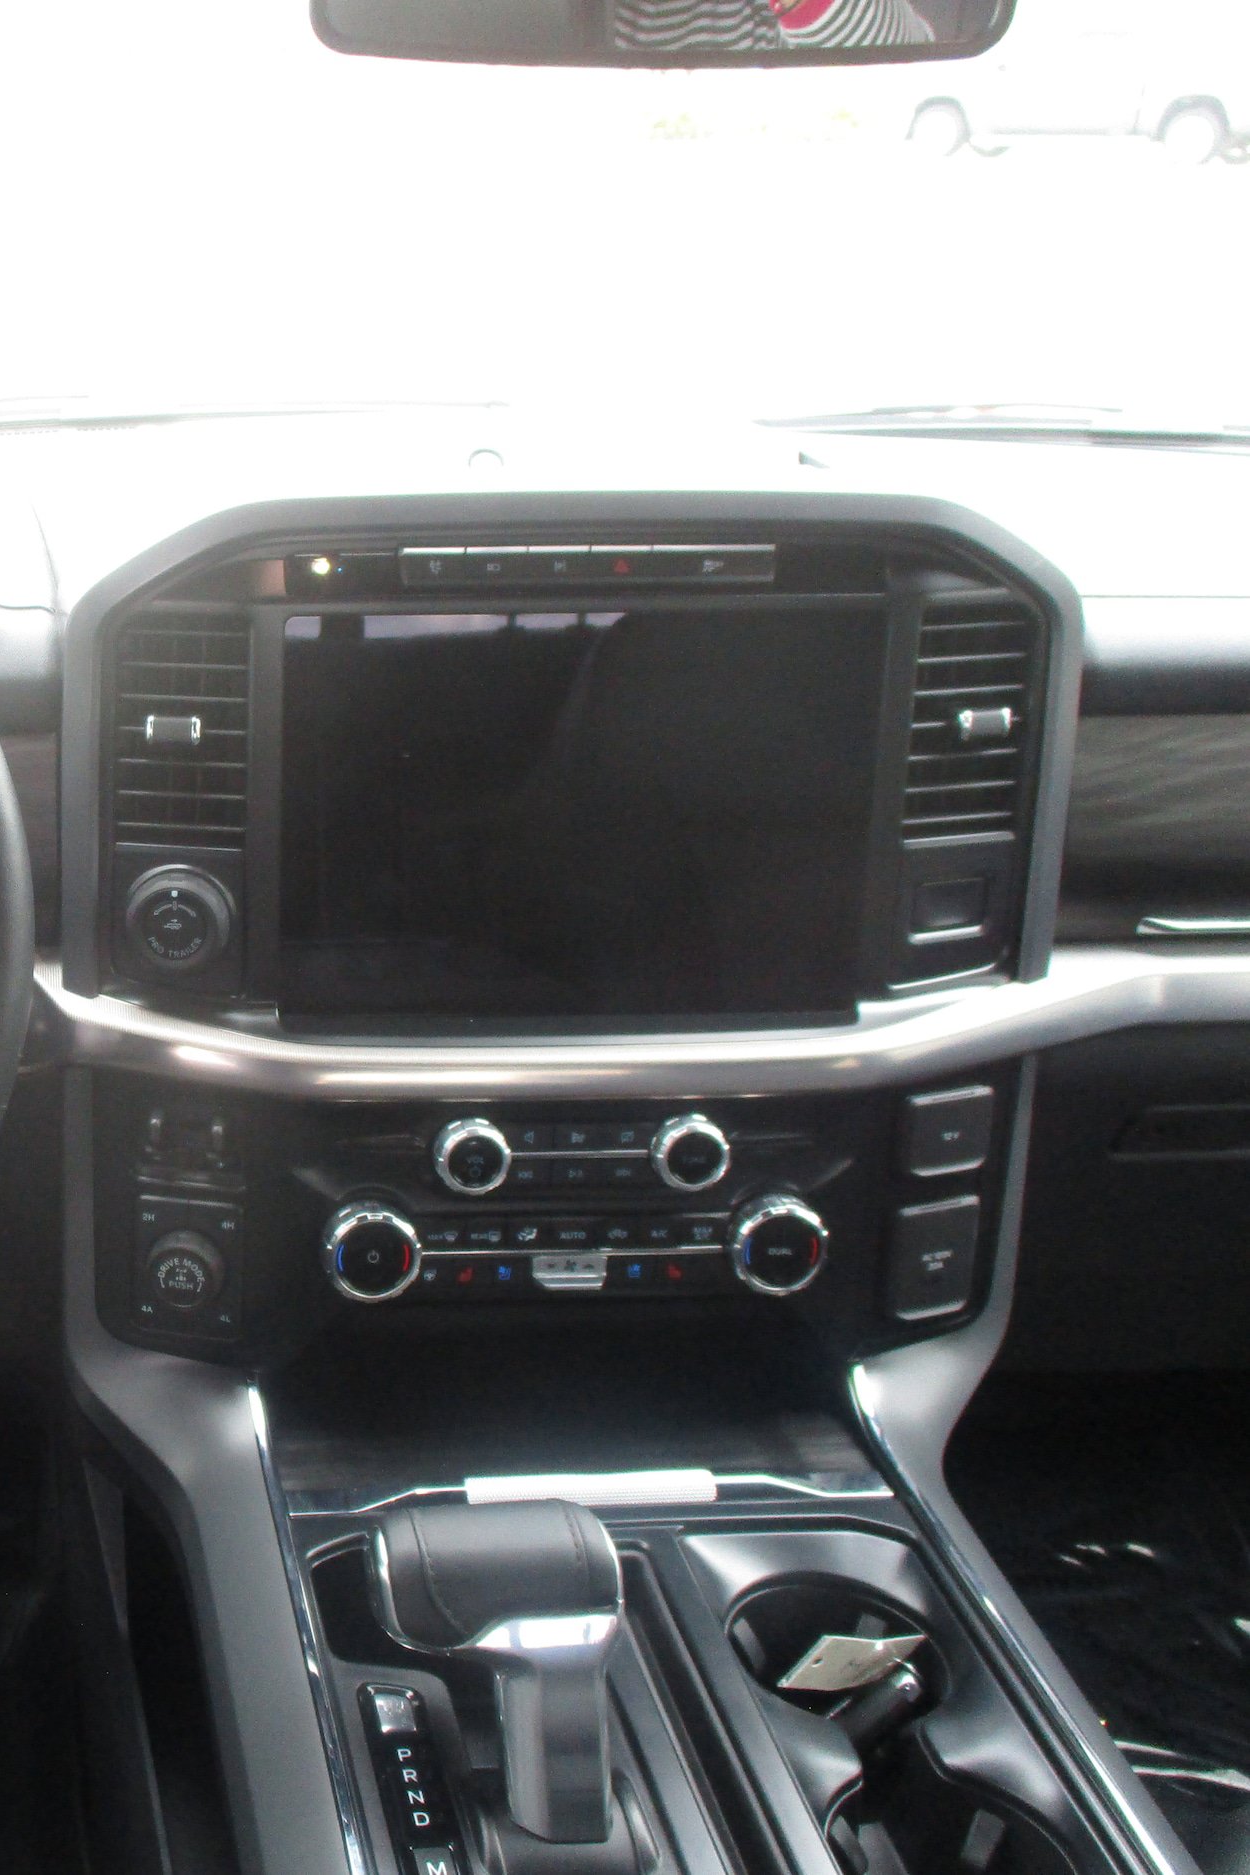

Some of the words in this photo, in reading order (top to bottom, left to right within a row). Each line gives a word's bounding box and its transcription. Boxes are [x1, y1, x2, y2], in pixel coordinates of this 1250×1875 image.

[148, 936, 164, 953] PRO
[168, 937, 202, 958] TRAILER
[142, 1213, 155, 1221] 2H
[221, 1222, 235, 1230] 4H
[559, 1231, 586, 1240] AUTO
[768, 1247, 792, 1256] DUAL
[158, 1258, 179, 1279] DRIVE
[183, 1259, 205, 1282] MODE
[169, 1280, 194, 1290] PUSH
[141, 1305, 153, 1313] 4A
[220, 1314, 230, 1322] 4L
[397, 1749, 411, 1762] P
[402, 1769, 418, 1782] R
[407, 1790, 425, 1804] N
[413, 1812, 430, 1826] D
[426, 1861, 447, 1875] M
